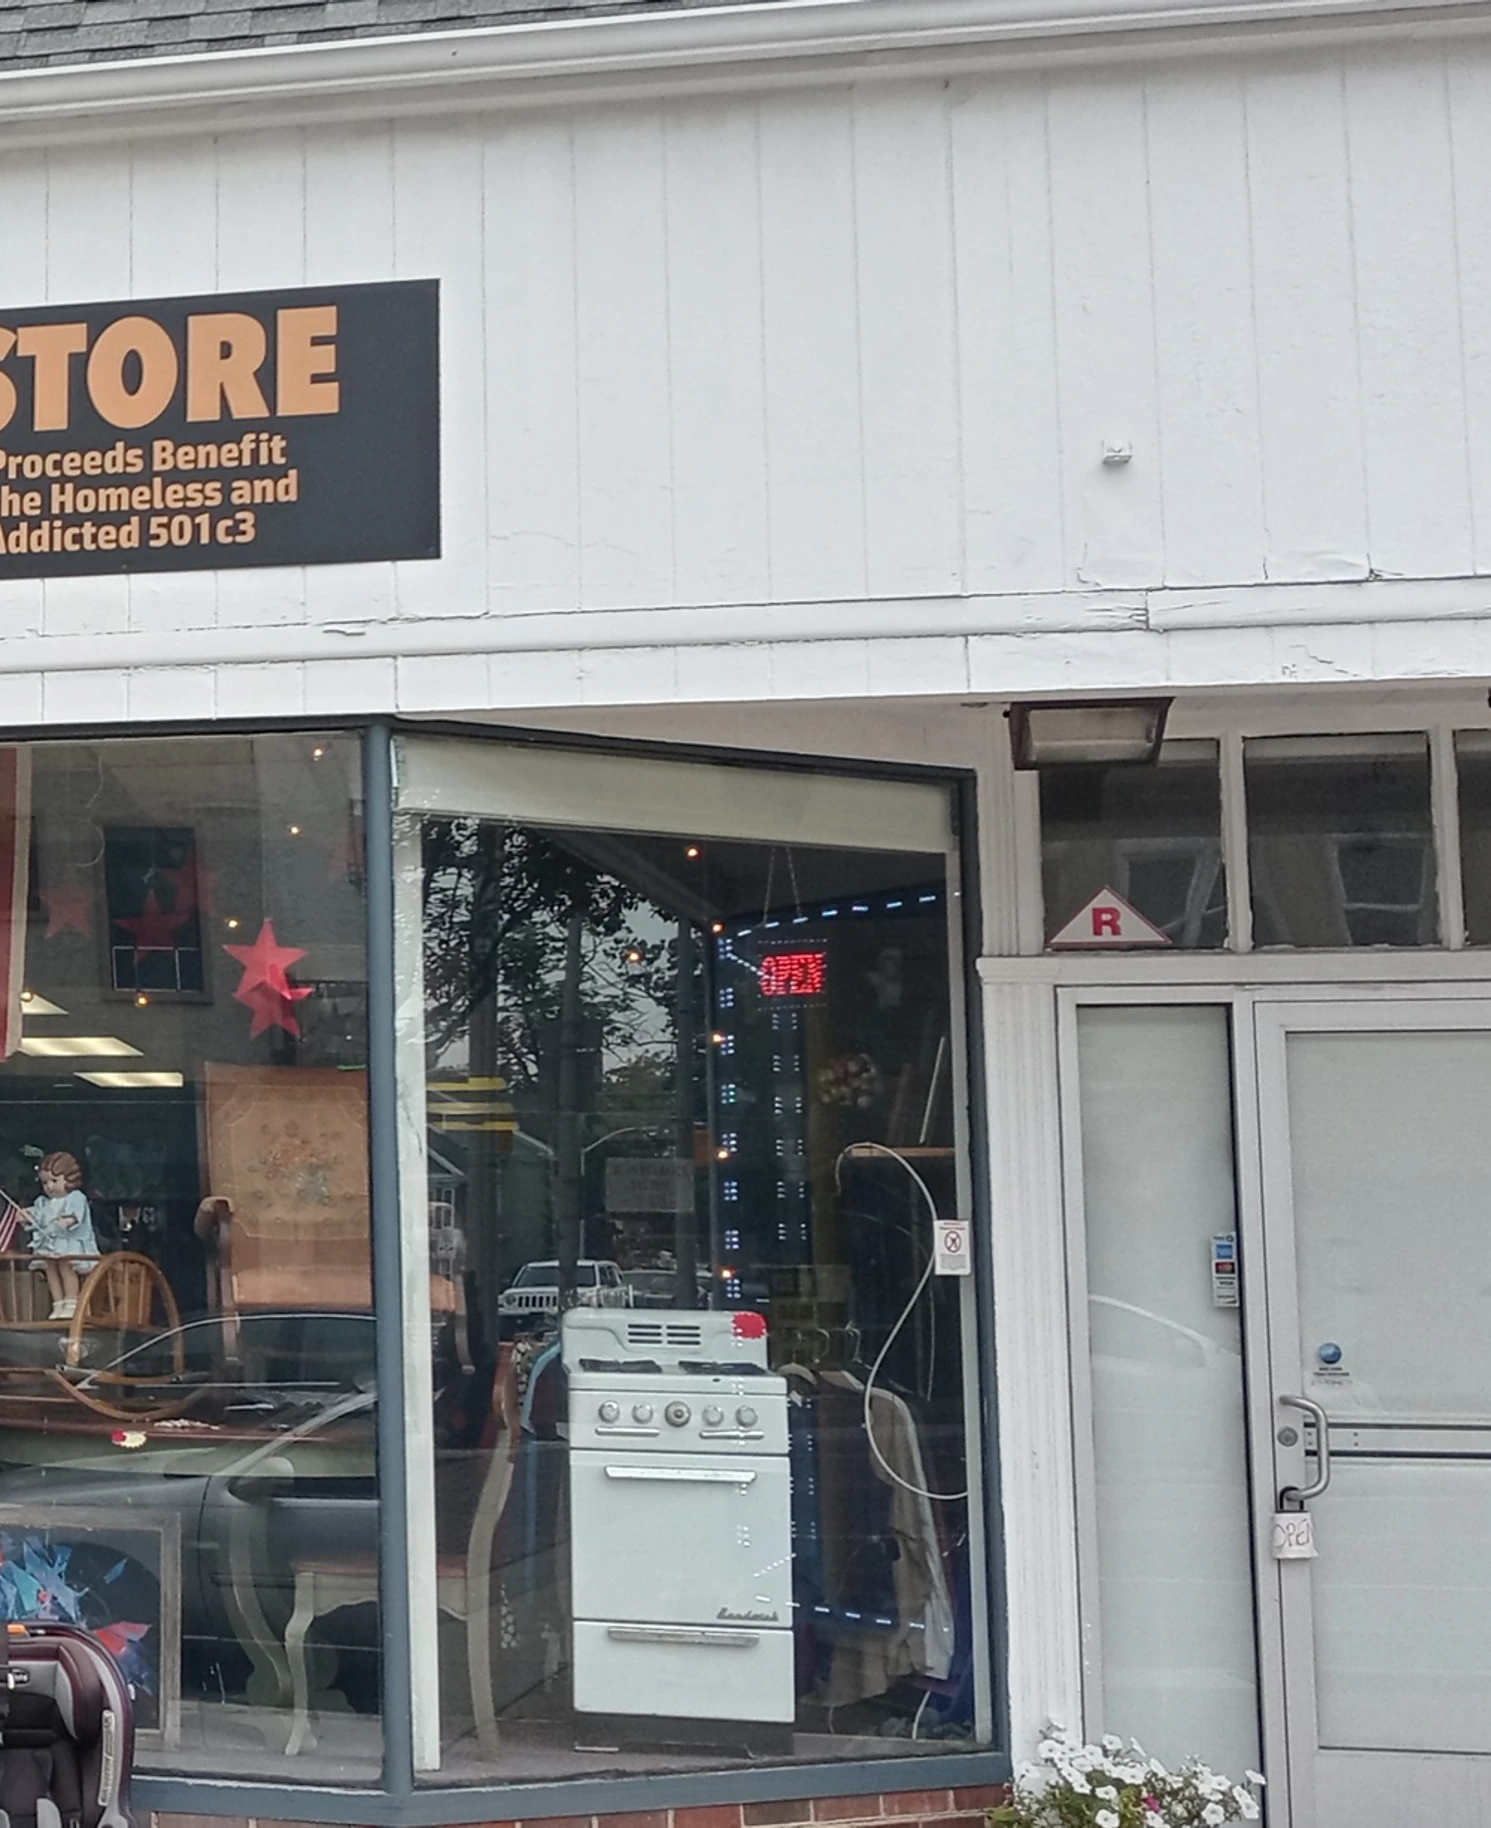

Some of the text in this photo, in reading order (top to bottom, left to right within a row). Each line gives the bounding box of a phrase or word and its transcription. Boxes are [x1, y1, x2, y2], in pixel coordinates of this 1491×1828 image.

[153, 432, 287, 471] Benefit
[51, 477, 222, 512] Homeless
[231, 468, 299, 502] and
[149, 510, 256, 546] 501c3
[1092, 907, 1122, 936] R
[760, 953, 824, 996] OPEN
